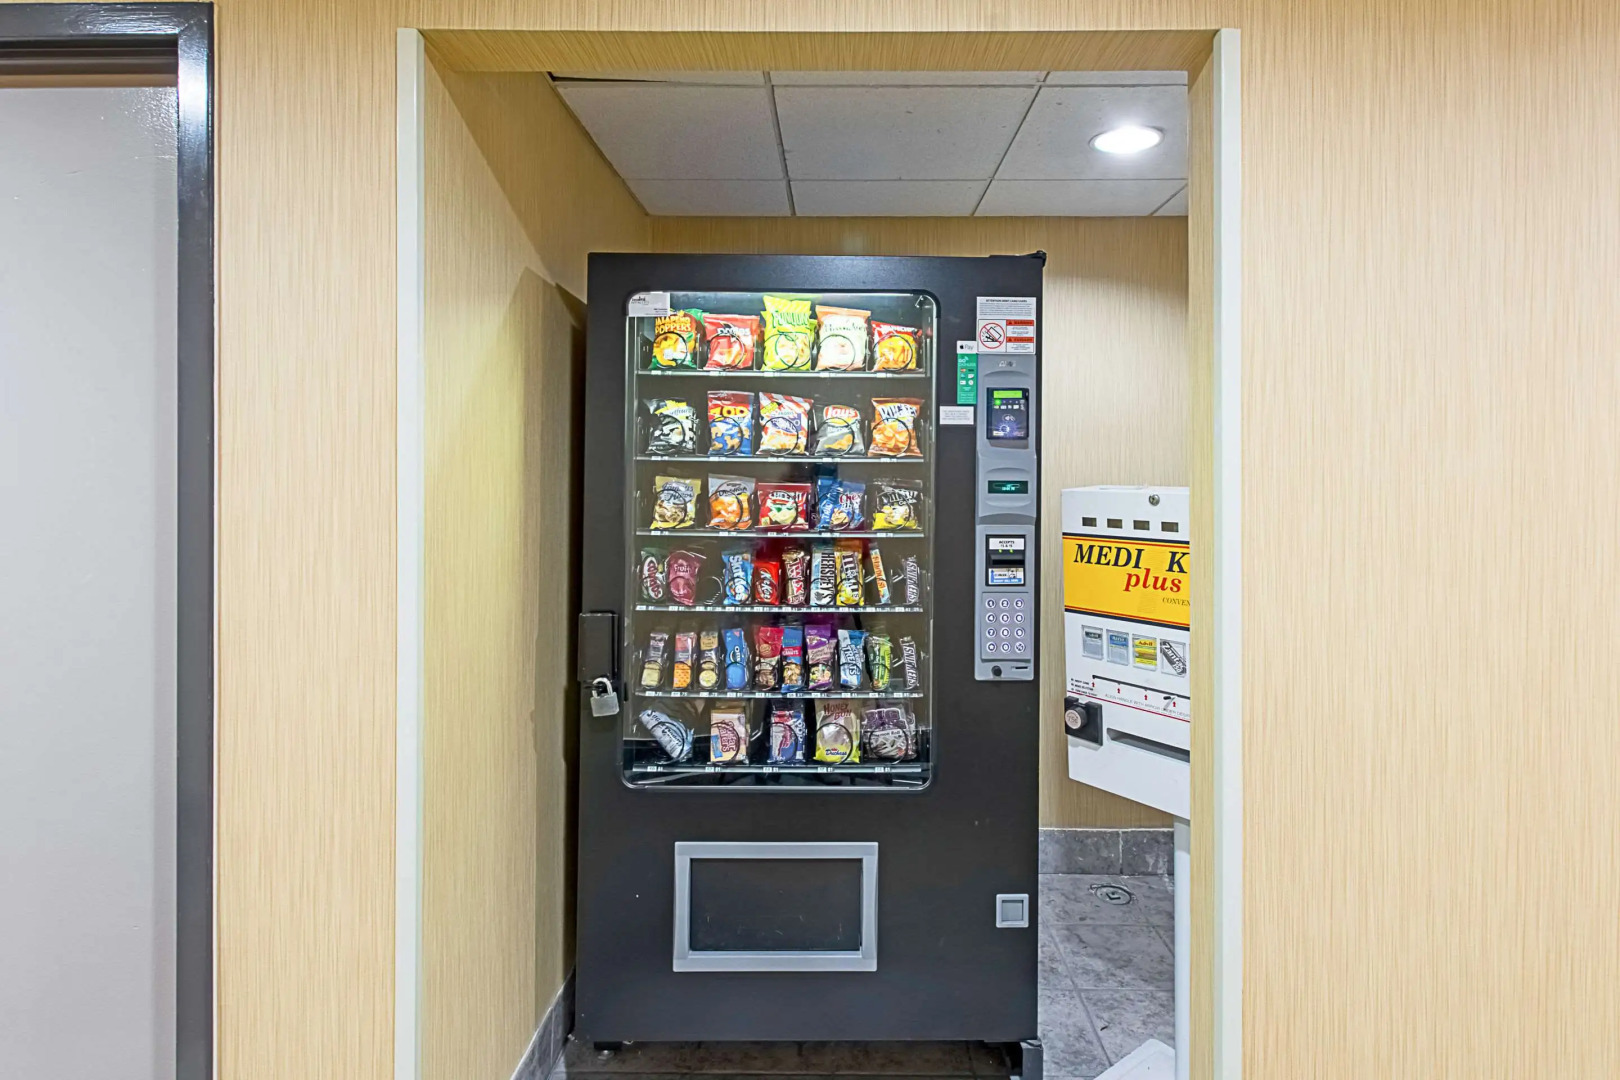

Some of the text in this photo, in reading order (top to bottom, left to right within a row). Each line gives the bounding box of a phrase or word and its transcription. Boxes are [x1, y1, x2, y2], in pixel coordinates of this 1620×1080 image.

[655, 323, 691, 334] POPPERS
[1073, 543, 1145, 570] MEDI
[729, 555, 747, 600] Skittles
[821, 552, 835, 600] HERSHEY'S
[907, 561, 919, 603] SNICKERS
[1123, 568, 1182, 593] plus
[841, 644, 857, 676] TREATS
[904, 644, 917, 687] SNICKERS
[1163, 641, 1187, 671] Zantac
[823, 702, 850, 715] HONEY
